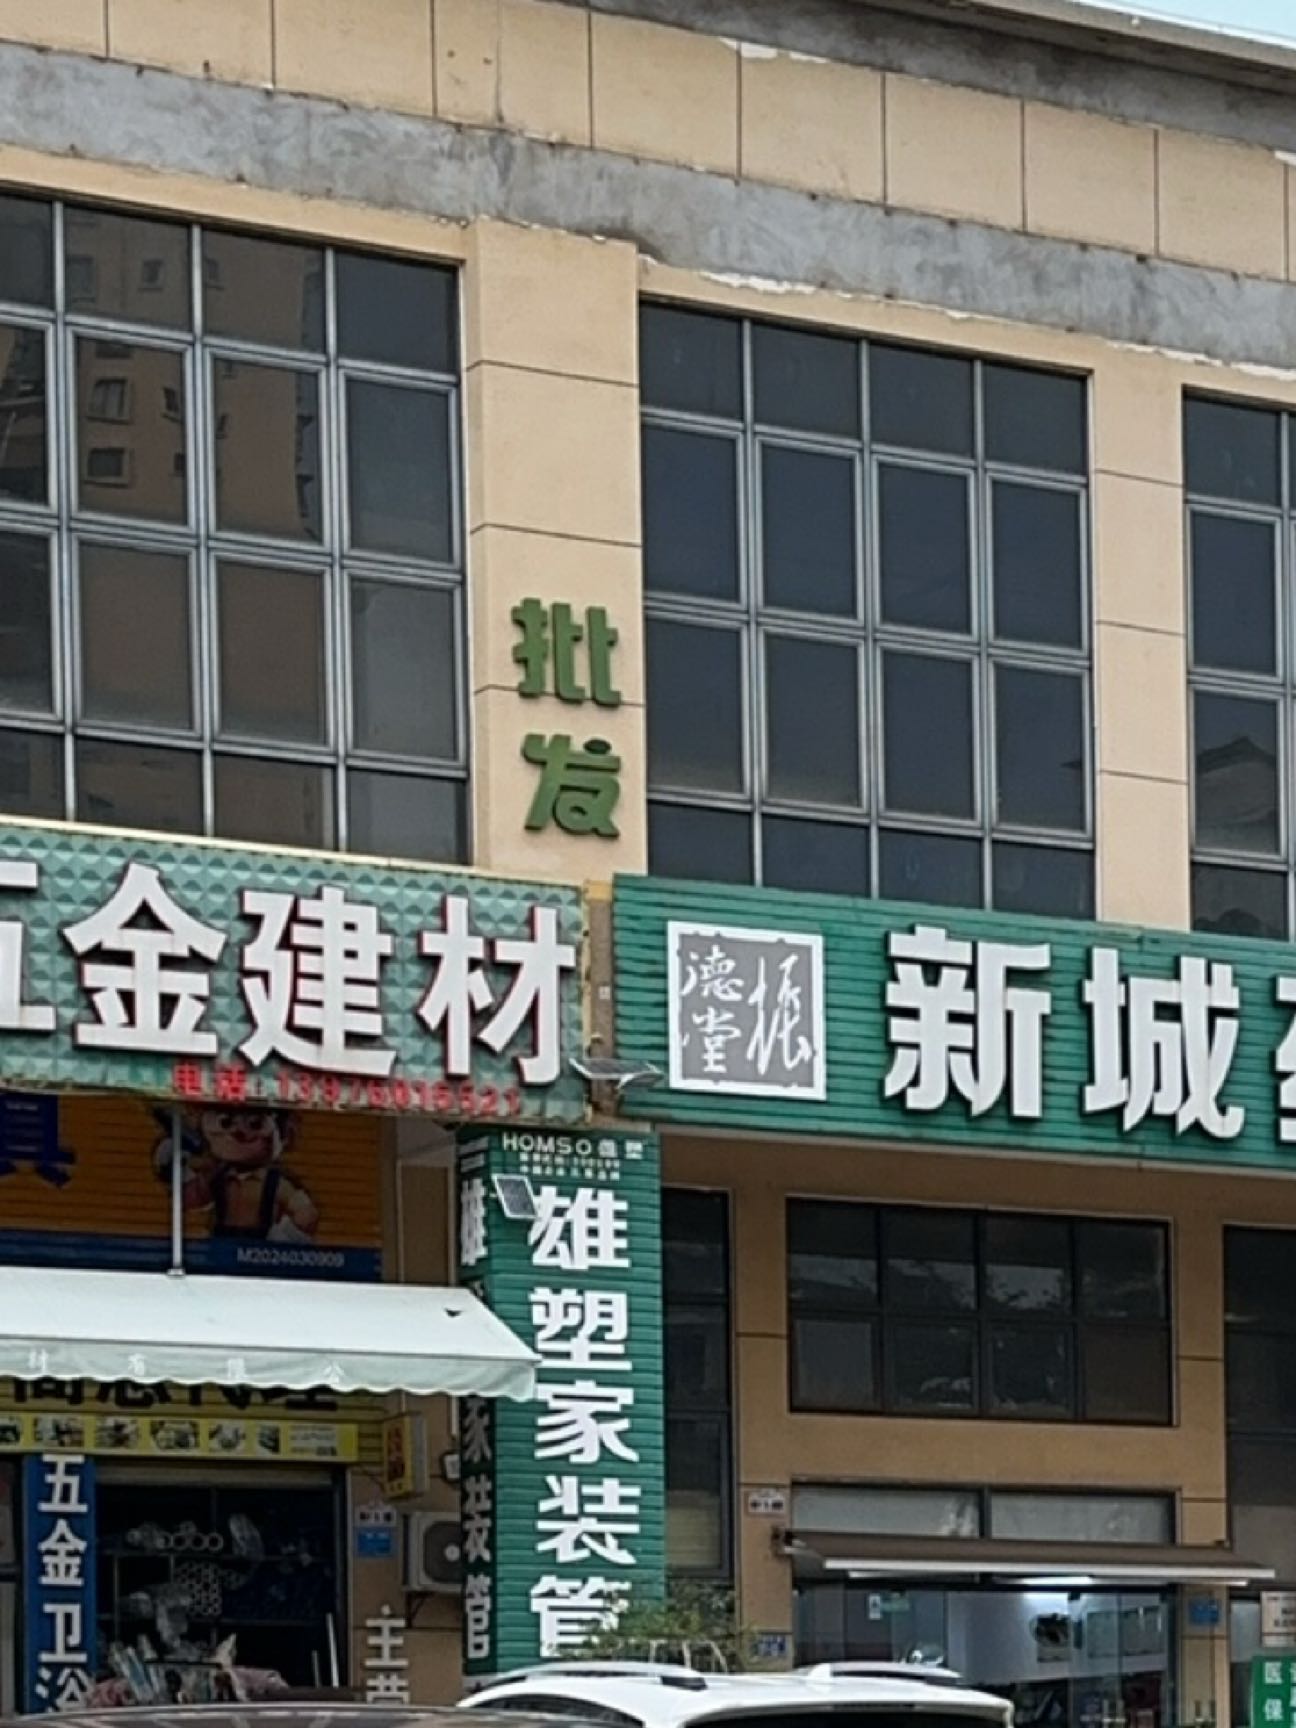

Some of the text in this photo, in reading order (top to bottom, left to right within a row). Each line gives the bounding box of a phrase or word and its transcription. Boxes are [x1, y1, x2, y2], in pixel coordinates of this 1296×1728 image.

[511, 598, 622, 838] 批发
[503, 1132, 593, 1155] HOMSO
[527, 1185, 641, 1657] 雄塑家装管
[35, 1454, 92, 1712] 五金卫浴
